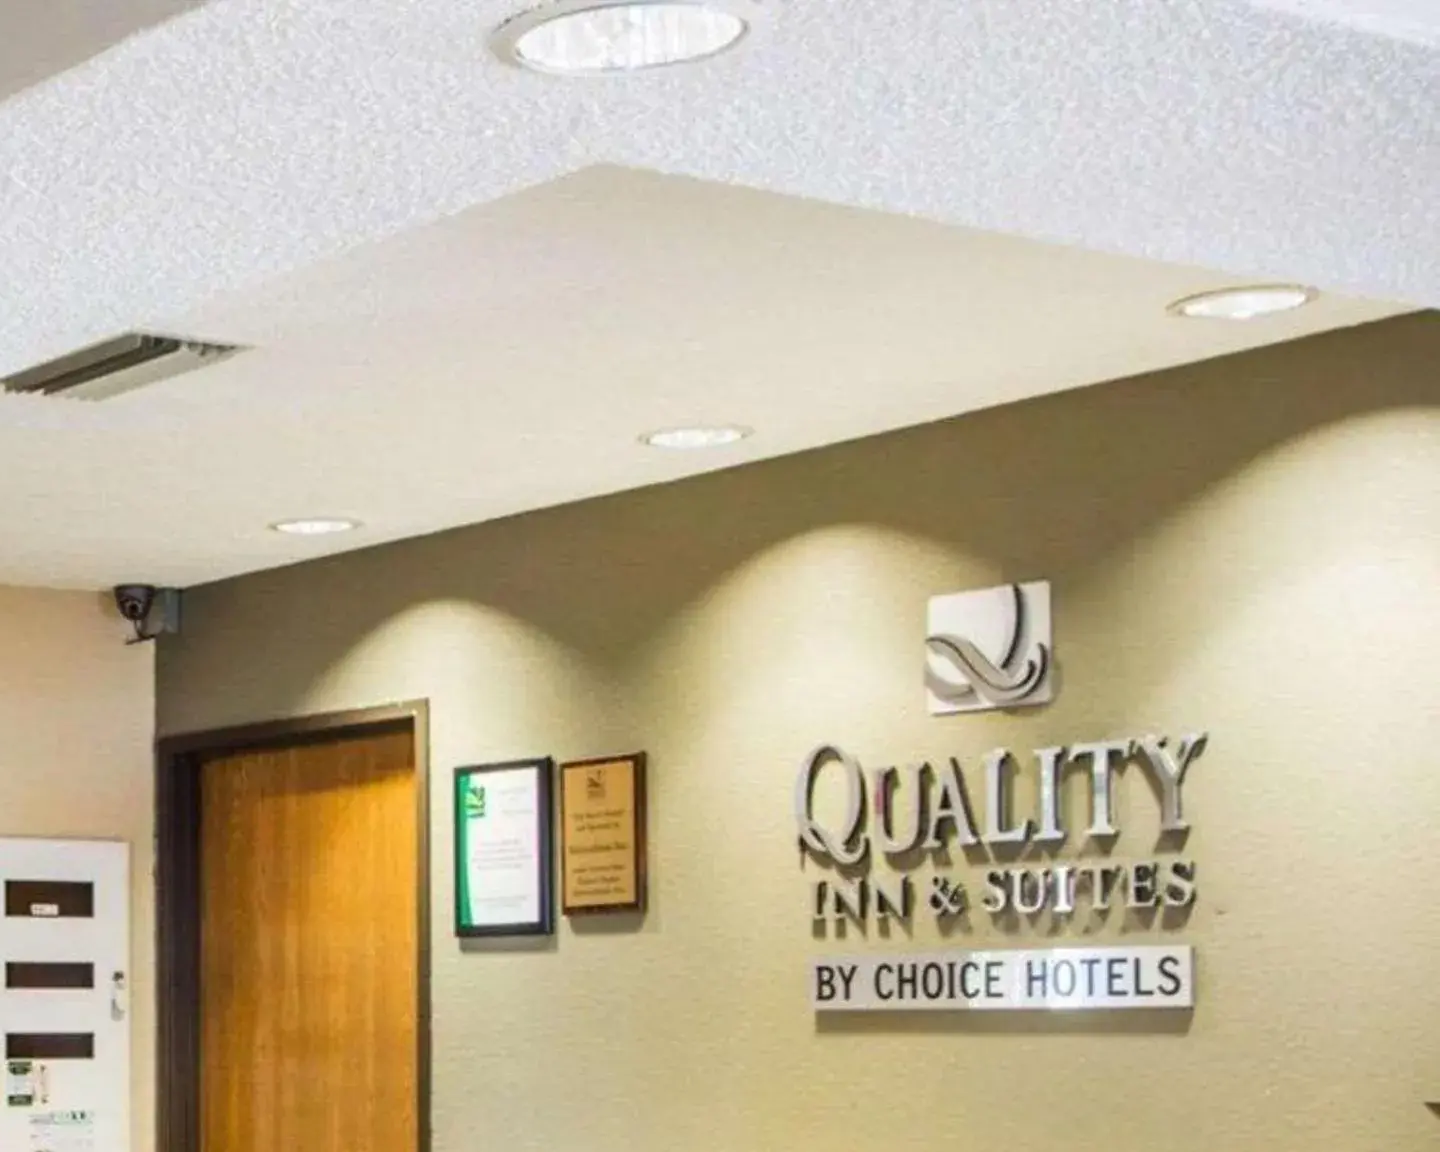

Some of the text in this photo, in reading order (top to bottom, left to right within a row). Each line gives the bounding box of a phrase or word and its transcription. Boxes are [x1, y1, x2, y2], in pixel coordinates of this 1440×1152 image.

[795, 732, 1207, 864] QUALITY
[813, 861, 1197, 922] INN & SUITES
[816, 955, 1182, 1001] BY CHOICE HOTELS
